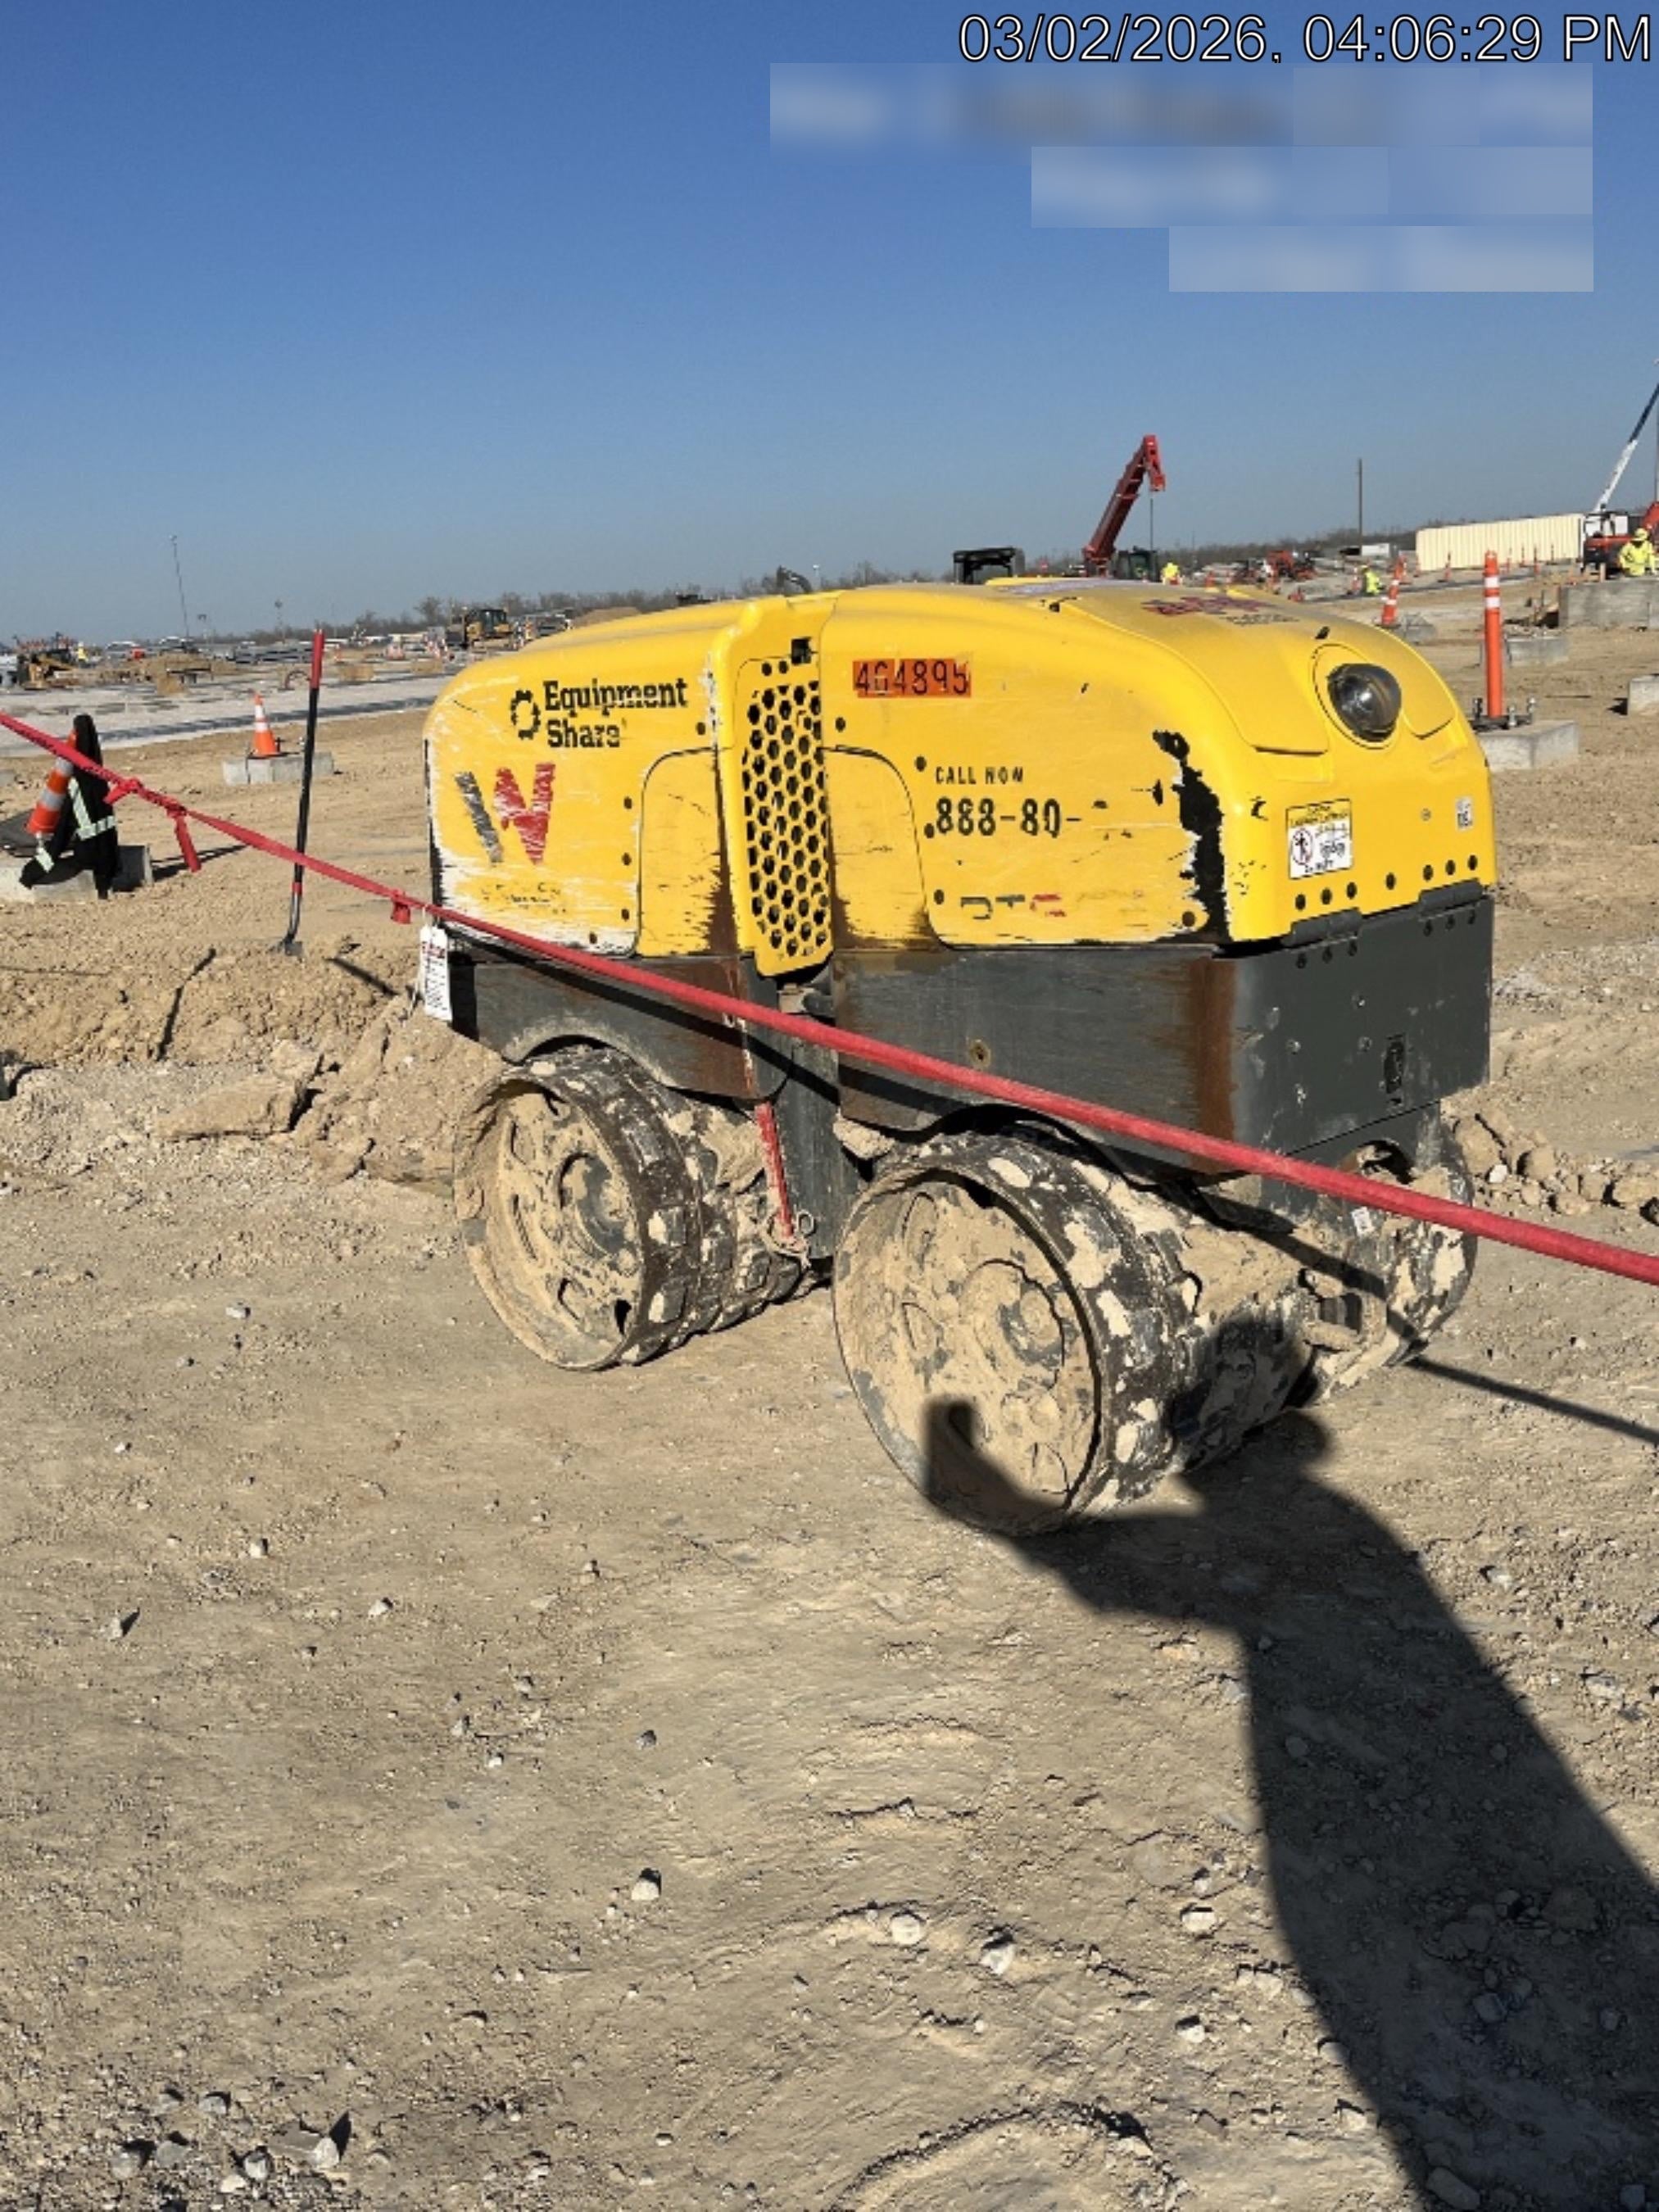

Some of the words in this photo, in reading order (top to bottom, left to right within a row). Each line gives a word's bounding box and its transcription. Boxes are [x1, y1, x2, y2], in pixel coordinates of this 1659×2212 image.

[543, 678, 687, 718] Equipment
[936, 766, 977, 785] CALL
[985, 766, 1024, 785] NOW
